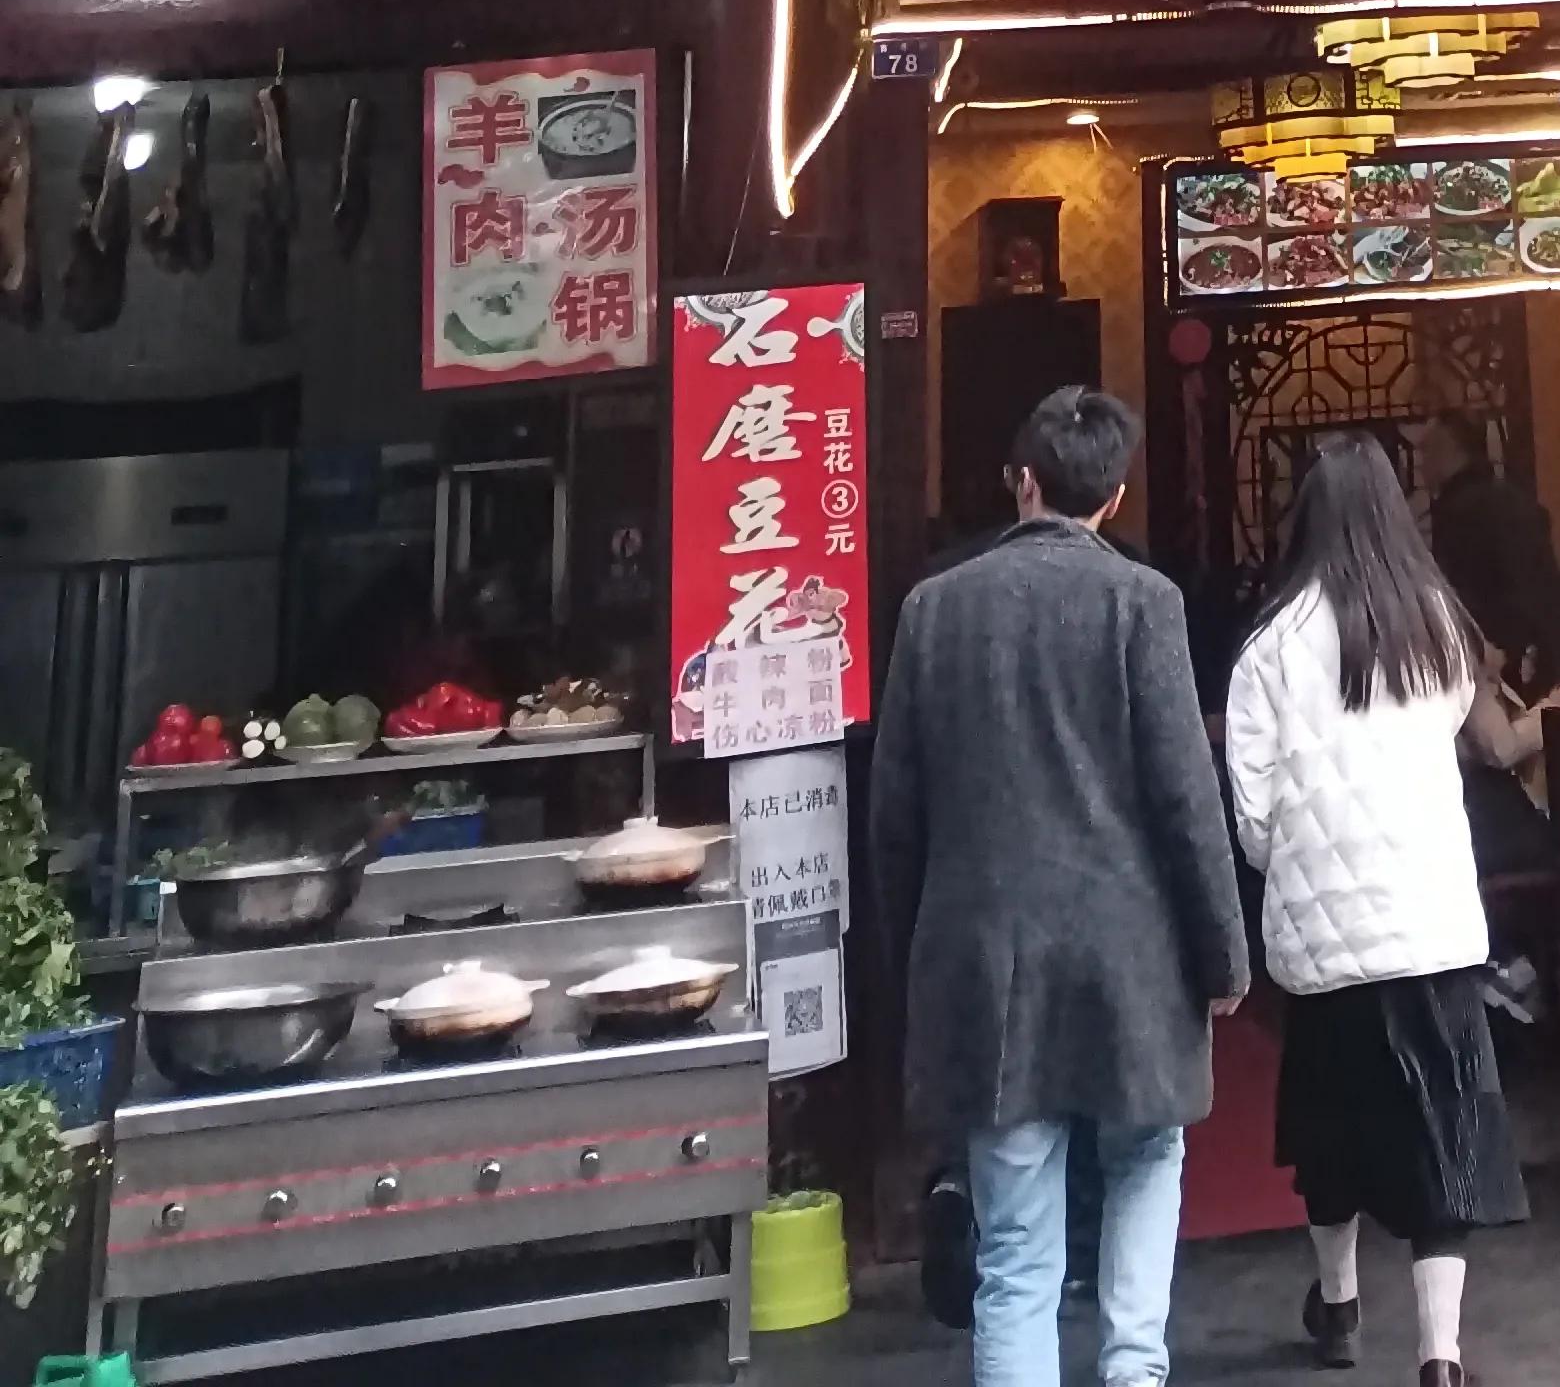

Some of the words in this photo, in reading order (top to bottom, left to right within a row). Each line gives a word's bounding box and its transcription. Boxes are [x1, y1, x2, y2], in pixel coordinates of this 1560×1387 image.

[888, 53, 918, 74] 78
[701, 297, 818, 651] 石磨豆花
[712, 680, 833, 718] 牛肉面
[751, 852, 830, 888] 出入本店
